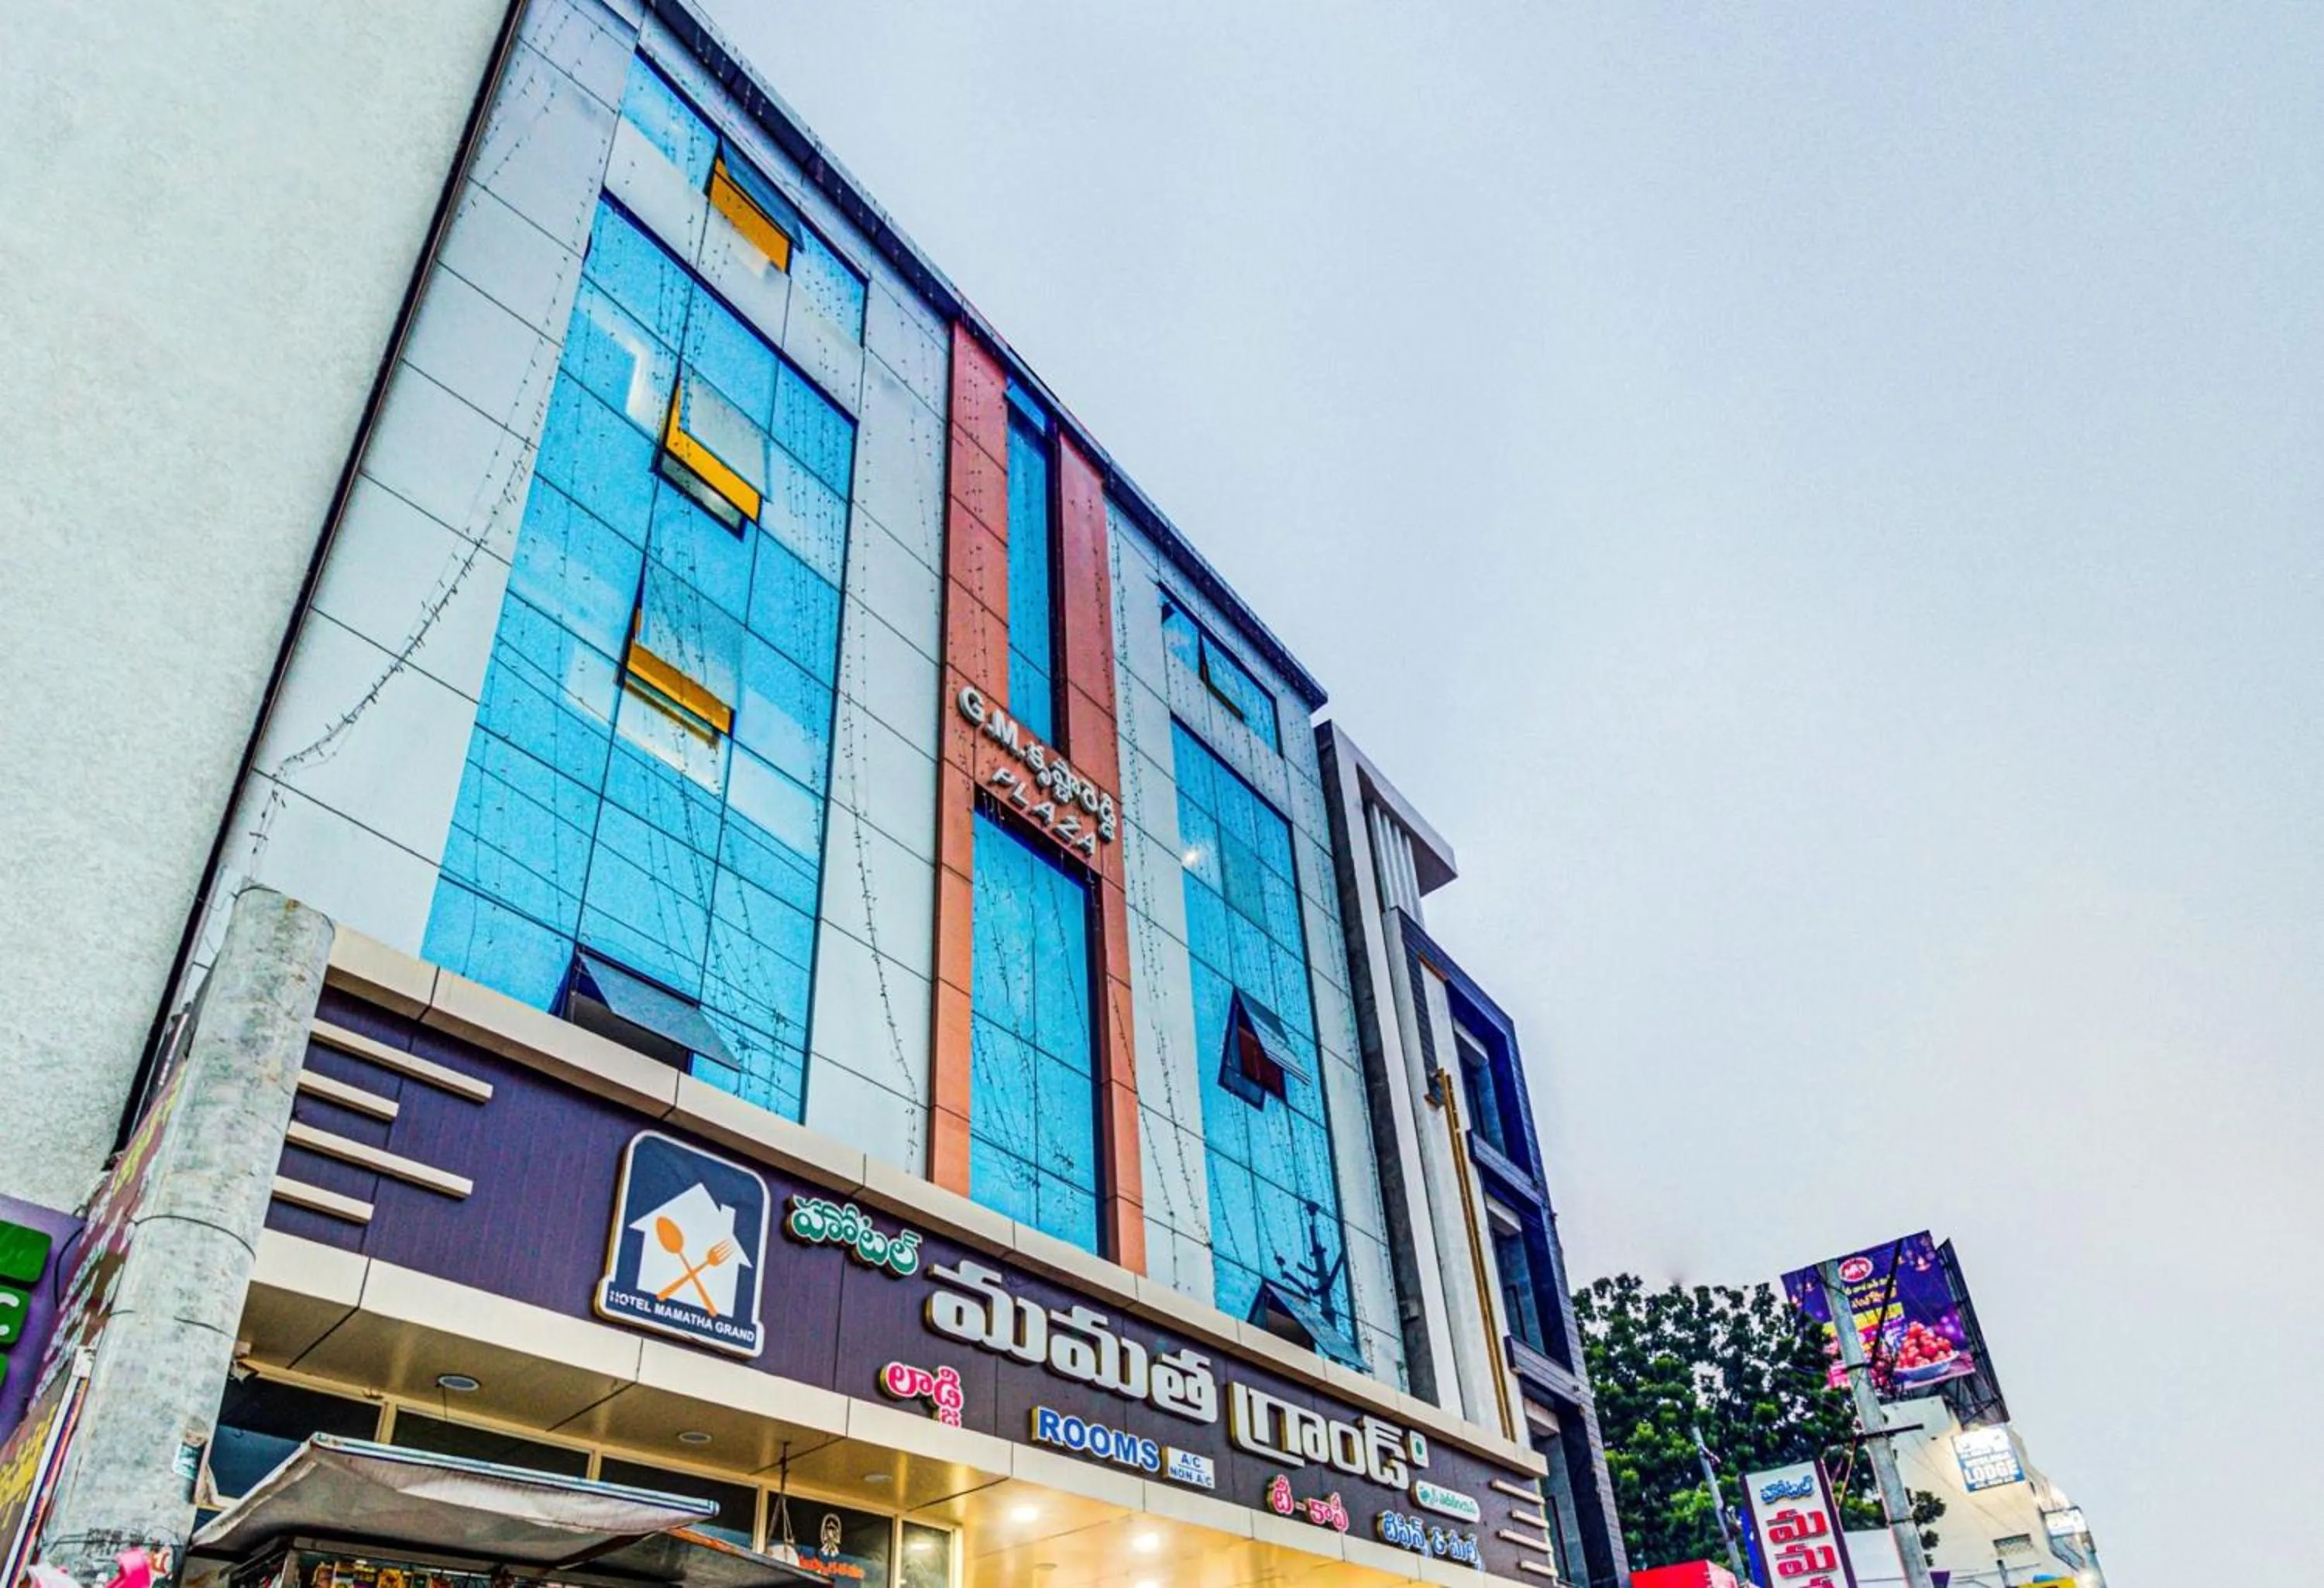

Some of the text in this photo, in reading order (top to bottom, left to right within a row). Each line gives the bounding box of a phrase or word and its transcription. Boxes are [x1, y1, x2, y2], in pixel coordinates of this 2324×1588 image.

[990, 767, 1097, 856] PLAZA
[792, 1194, 923, 1276] హోటల్
[609, 1290, 755, 1342] HOTEL MAMATHA GRAND
[930, 1260, 1218, 1424] మమత
[1037, 1406, 1160, 1472] ROOMS
[1963, 1458, 2020, 1484] LODGE
[1170, 1466, 1192, 1481] NON
